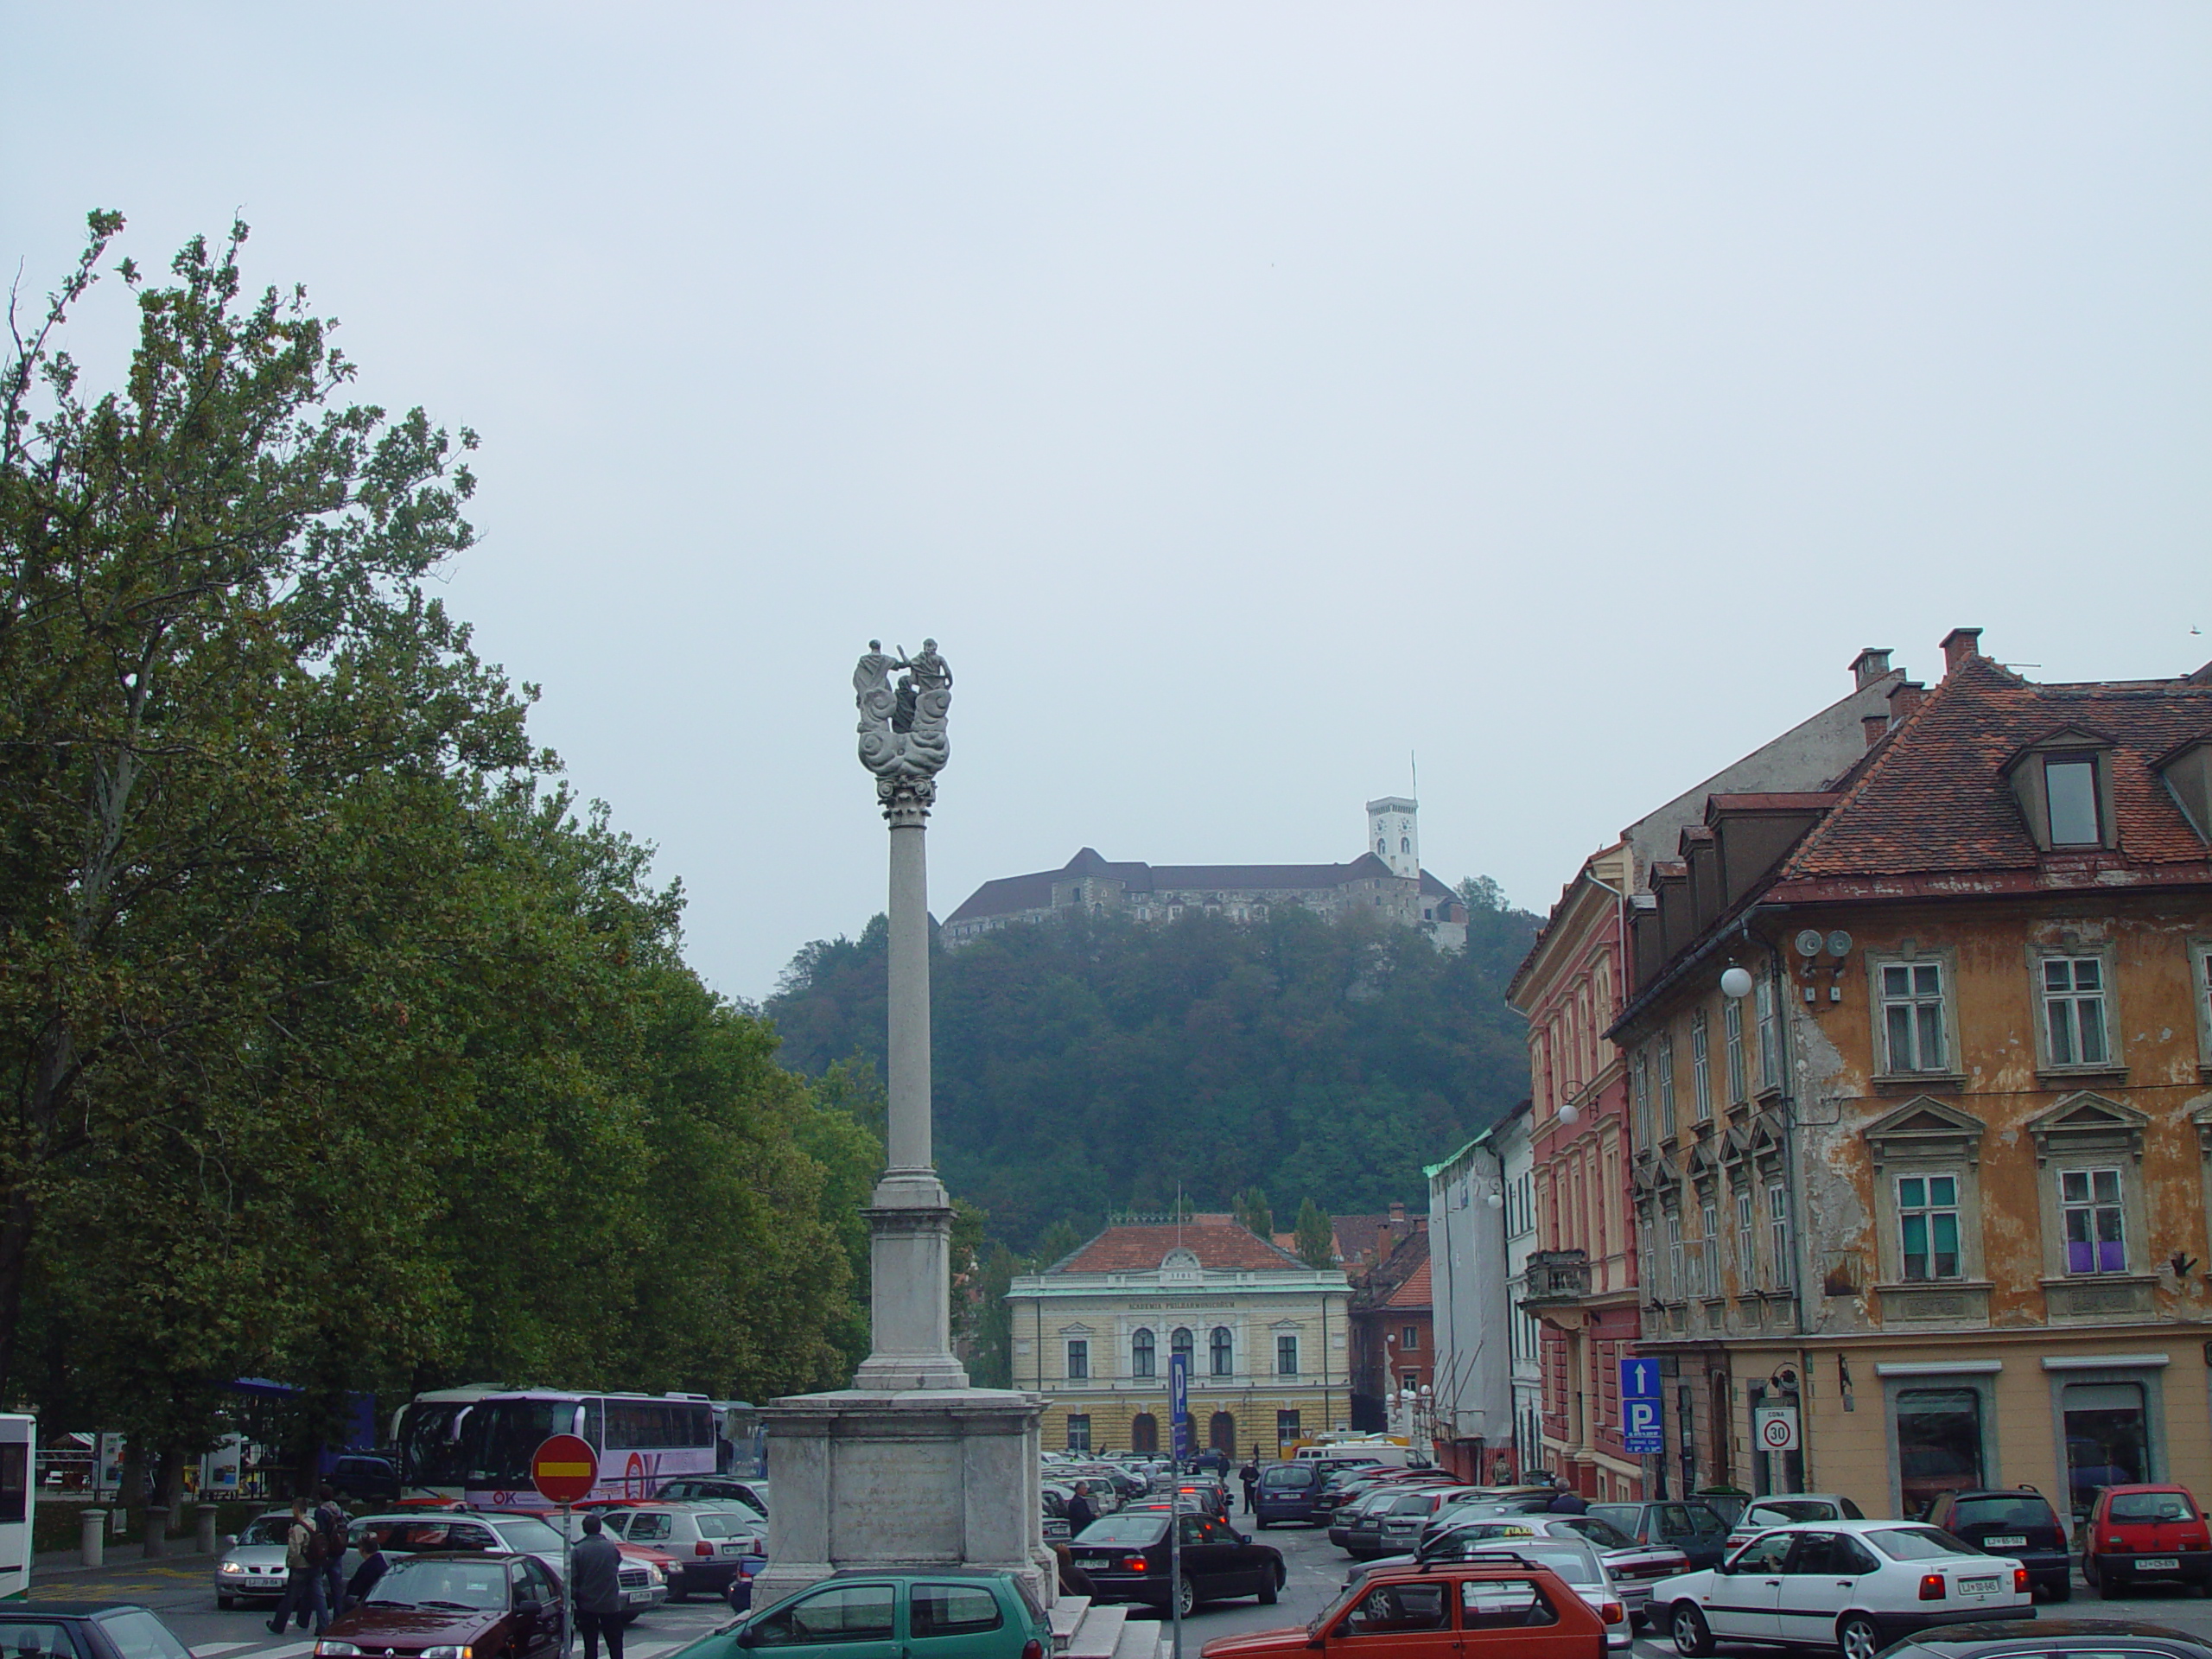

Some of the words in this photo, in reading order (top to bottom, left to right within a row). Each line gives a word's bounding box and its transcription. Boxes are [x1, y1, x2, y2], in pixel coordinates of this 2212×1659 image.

[1175, 1363, 1185, 1413] P
[1632, 1404, 1653, 1432] P
[1770, 1427, 1785, 1440] 30
[493, 1491, 517, 1504] OK
[1505, 1526, 1532, 1535] TAXI
